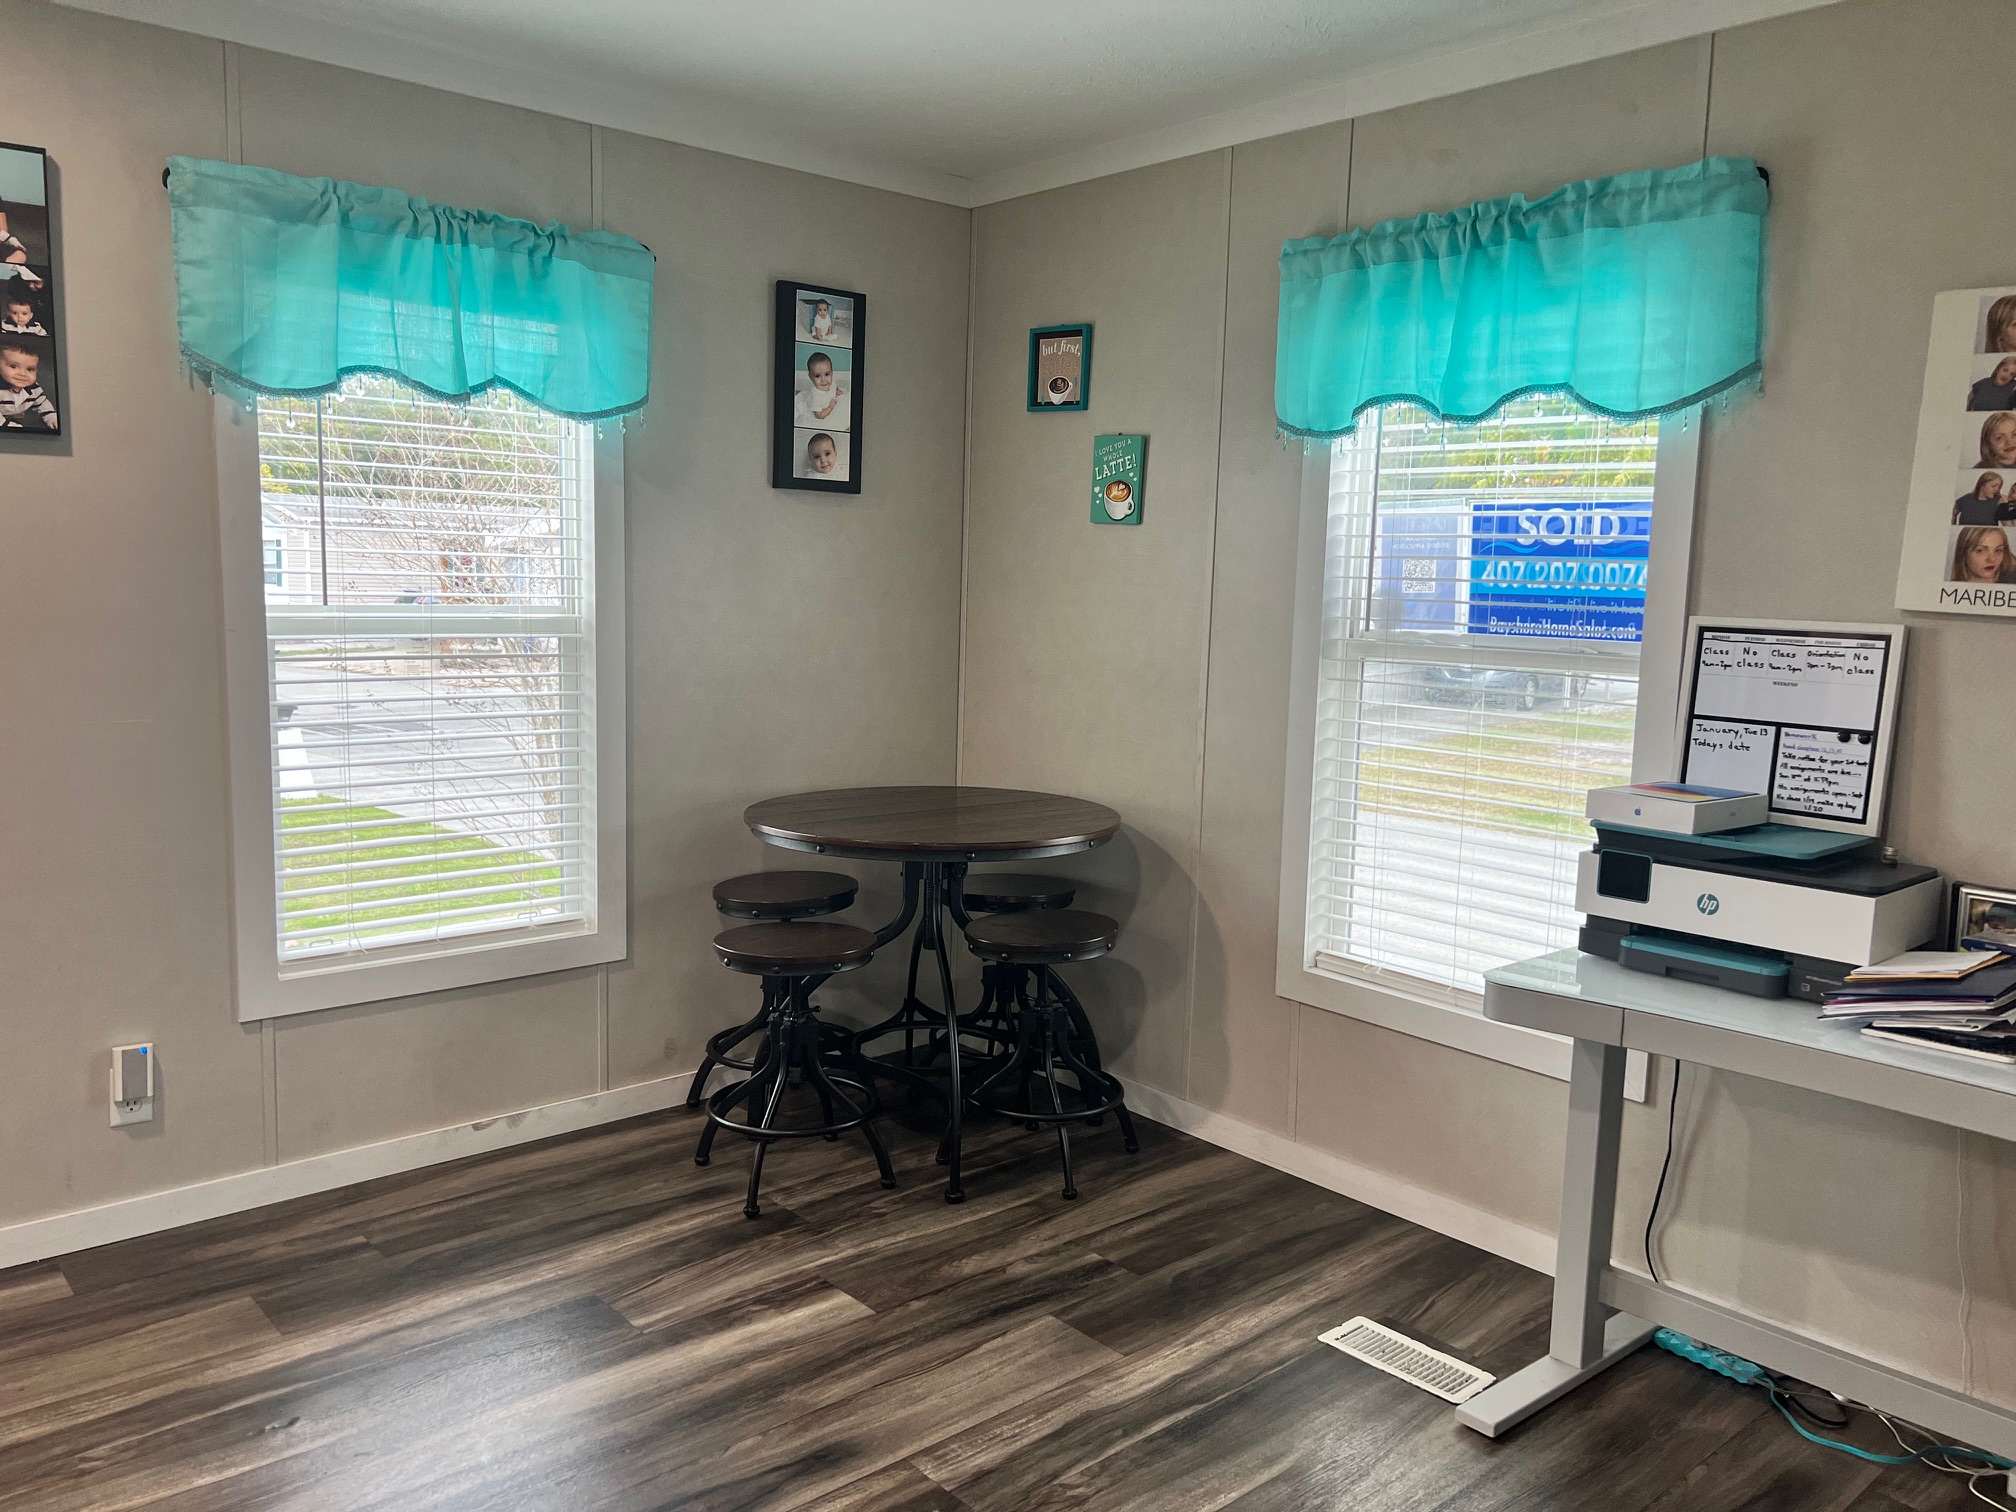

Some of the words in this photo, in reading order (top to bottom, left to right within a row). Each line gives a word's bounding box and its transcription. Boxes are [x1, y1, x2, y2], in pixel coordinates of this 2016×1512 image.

[1042, 342, 1057, 356] but
[1058, 340, 1080, 357] first,
[1098, 445, 1113, 456] LOVE
[1114, 440, 1126, 450] YOU
[1103, 450, 1123, 461] WHOLE
[1095, 453, 1137, 480] LATTE!
[1516, 508, 1620, 546] SOLD
[1939, 587, 2016, 608] MARIBE
[1703, 647, 1730, 656] Class
[1743, 646, 1757, 656] No
[1771, 649, 1796, 659] Class
[1853, 653, 1869, 661] No
[1736, 658, 1765, 668] class
[1846, 666, 1875, 675] class
[1696, 723, 1742, 740] January,
[1760, 728, 1768, 736] 13
[1692, 738, 1723, 752] Todays
[1728, 741, 1751, 751] date
[1804, 804, 1824, 812] 1/20
[1698, 893, 1718, 915] hp
